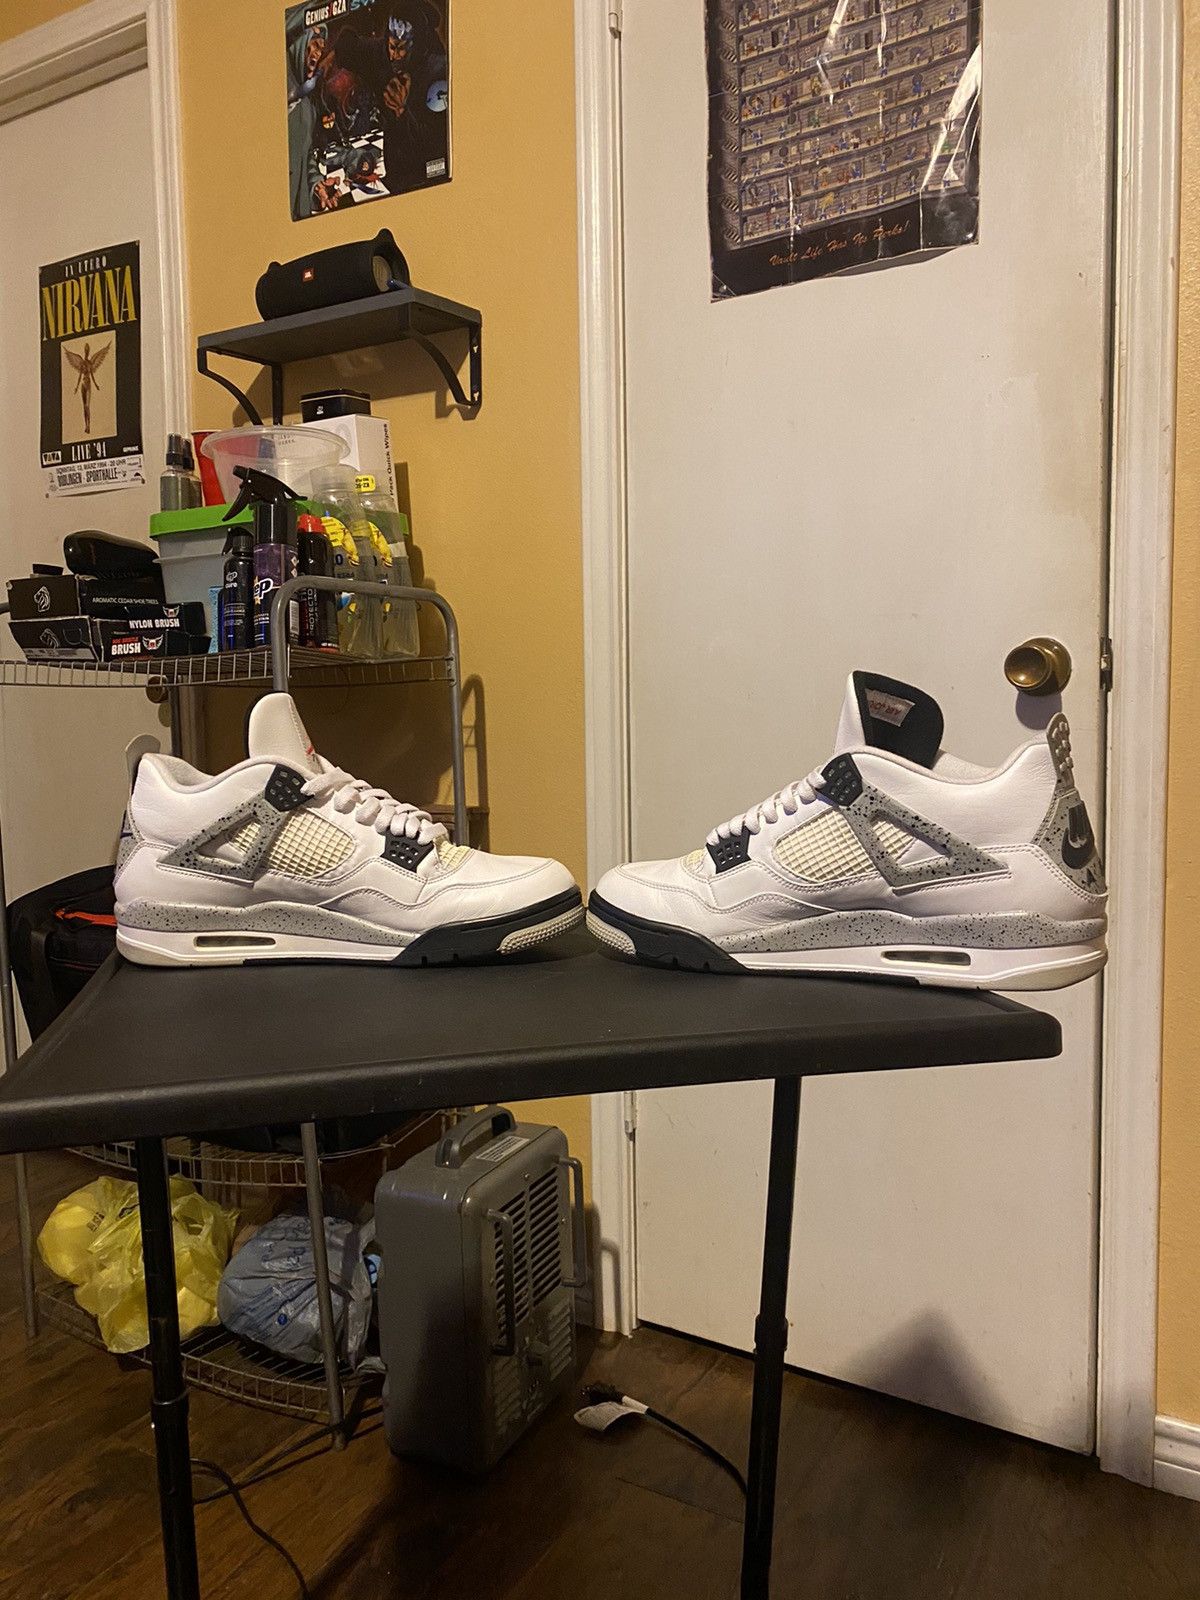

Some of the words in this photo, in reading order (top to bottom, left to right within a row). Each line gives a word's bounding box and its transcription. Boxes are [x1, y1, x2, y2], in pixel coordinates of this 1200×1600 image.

[769, 252, 798, 266] Vault
[801, 246, 823, 260] Life
[827, 240, 848, 252] Has
[873, 220, 910, 239] Perks!
[41, 265, 138, 341] NIRVANA
[128, 619, 153, 629] NYLON
[154, 618, 180, 628] BRUSH
[111, 642, 142, 655] BRUSH
